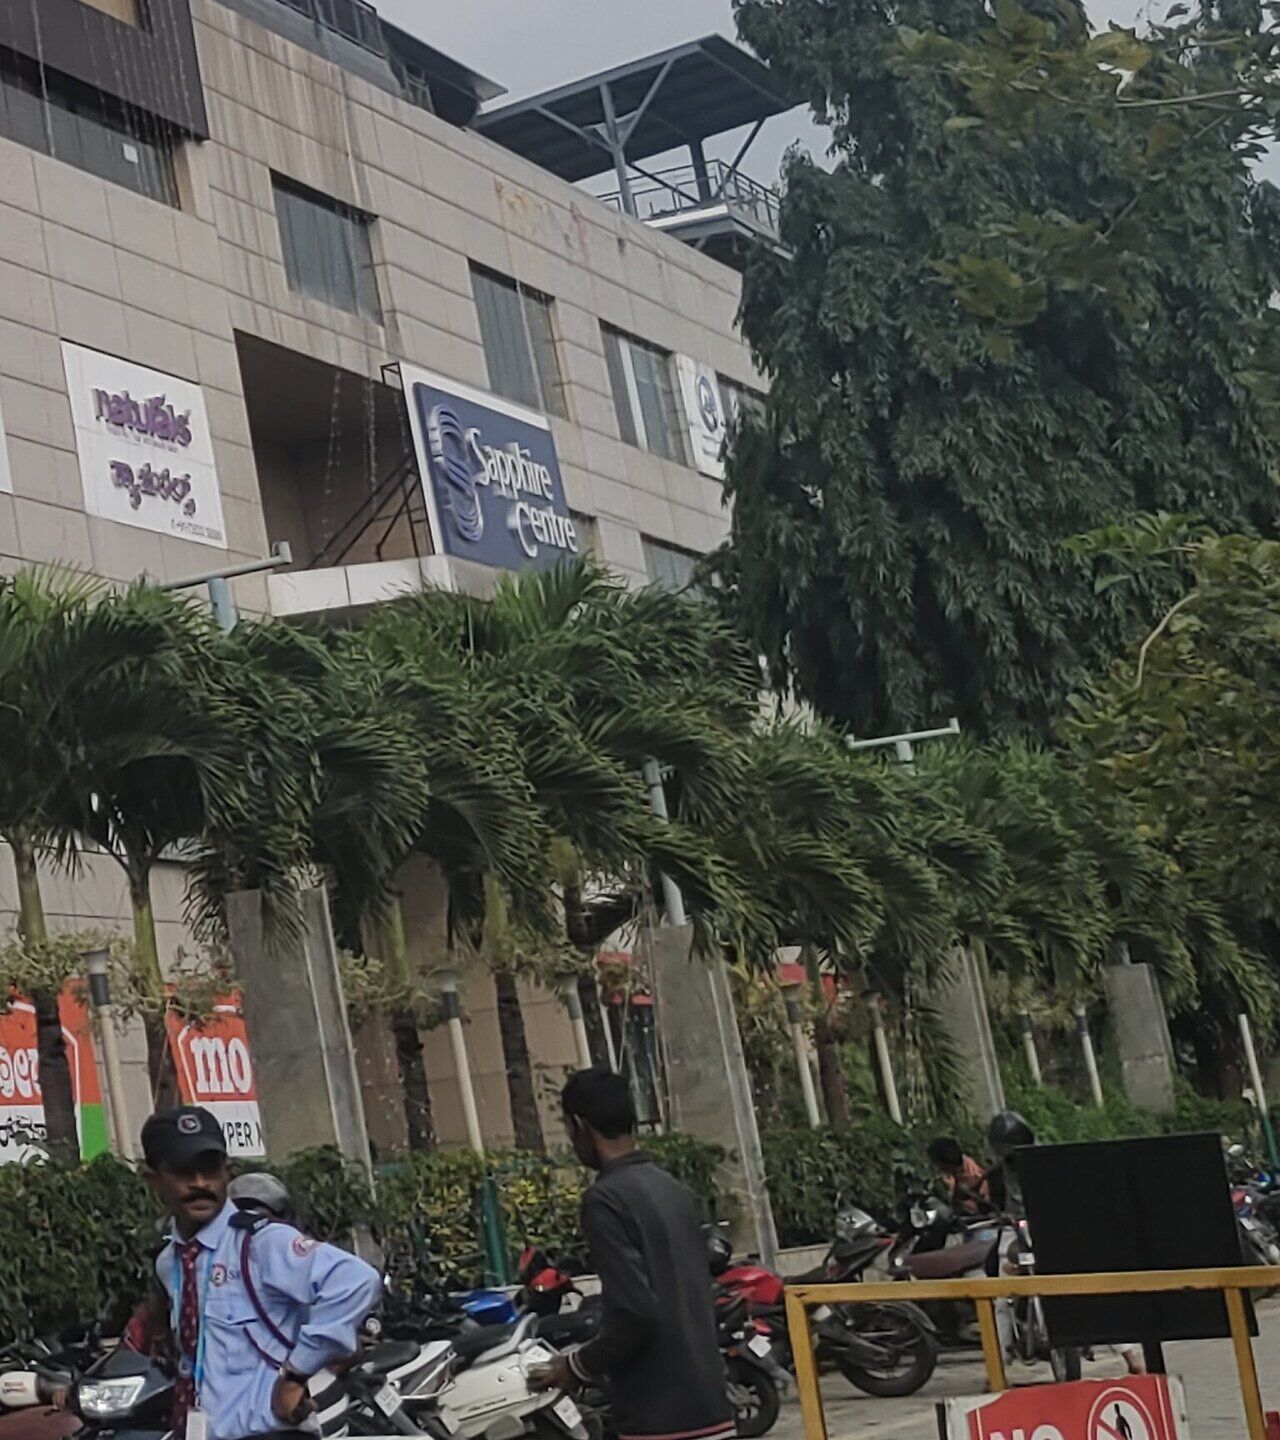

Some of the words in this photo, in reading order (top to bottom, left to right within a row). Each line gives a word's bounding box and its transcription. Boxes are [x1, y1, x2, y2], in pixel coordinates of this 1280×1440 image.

[465, 426, 554, 501] Sapphire
[513, 501, 579, 558] Centre
[189, 1035, 252, 1093] mo
[222, 1121, 254, 1147] PER
